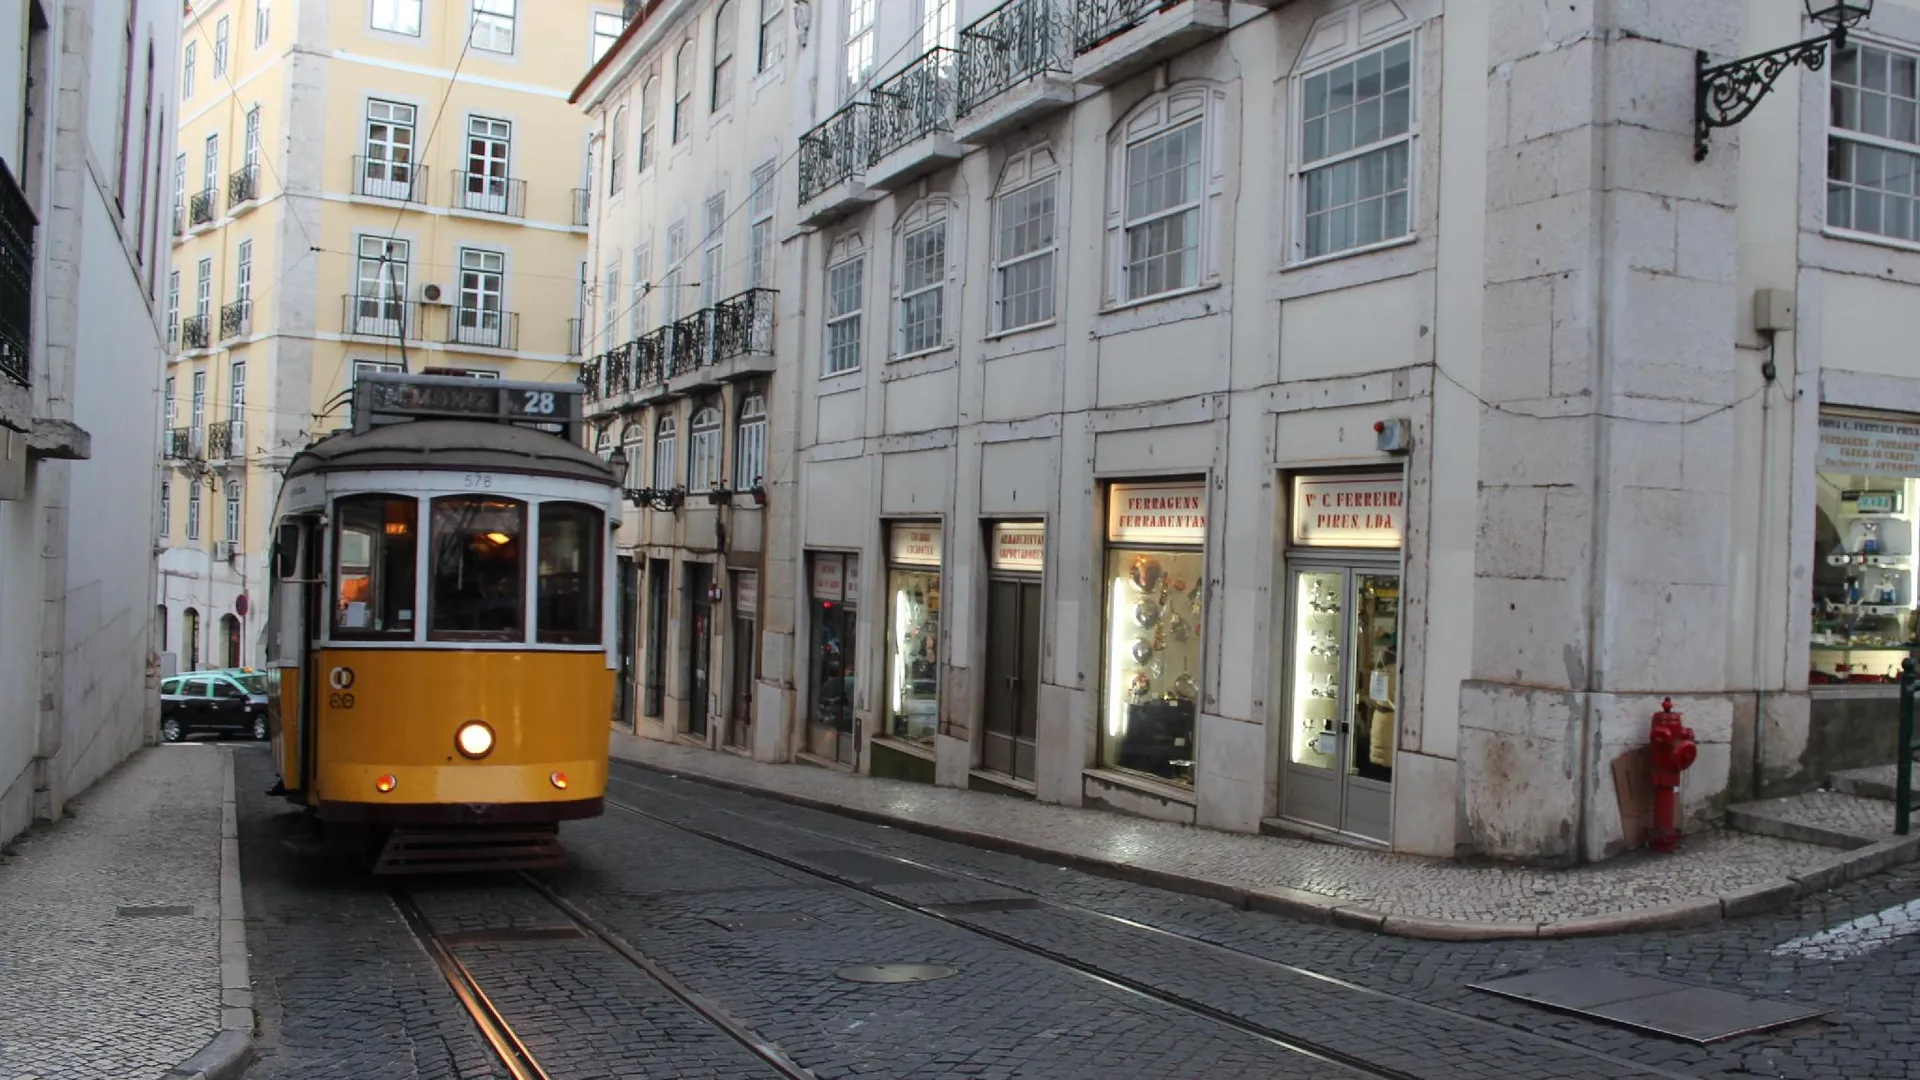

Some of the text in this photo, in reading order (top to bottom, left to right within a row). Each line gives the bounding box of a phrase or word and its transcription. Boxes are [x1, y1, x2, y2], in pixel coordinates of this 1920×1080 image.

[524, 391, 555, 413] 28
[463, 474, 492, 488] 578
[1128, 496, 1199, 510] FERRAGENS
